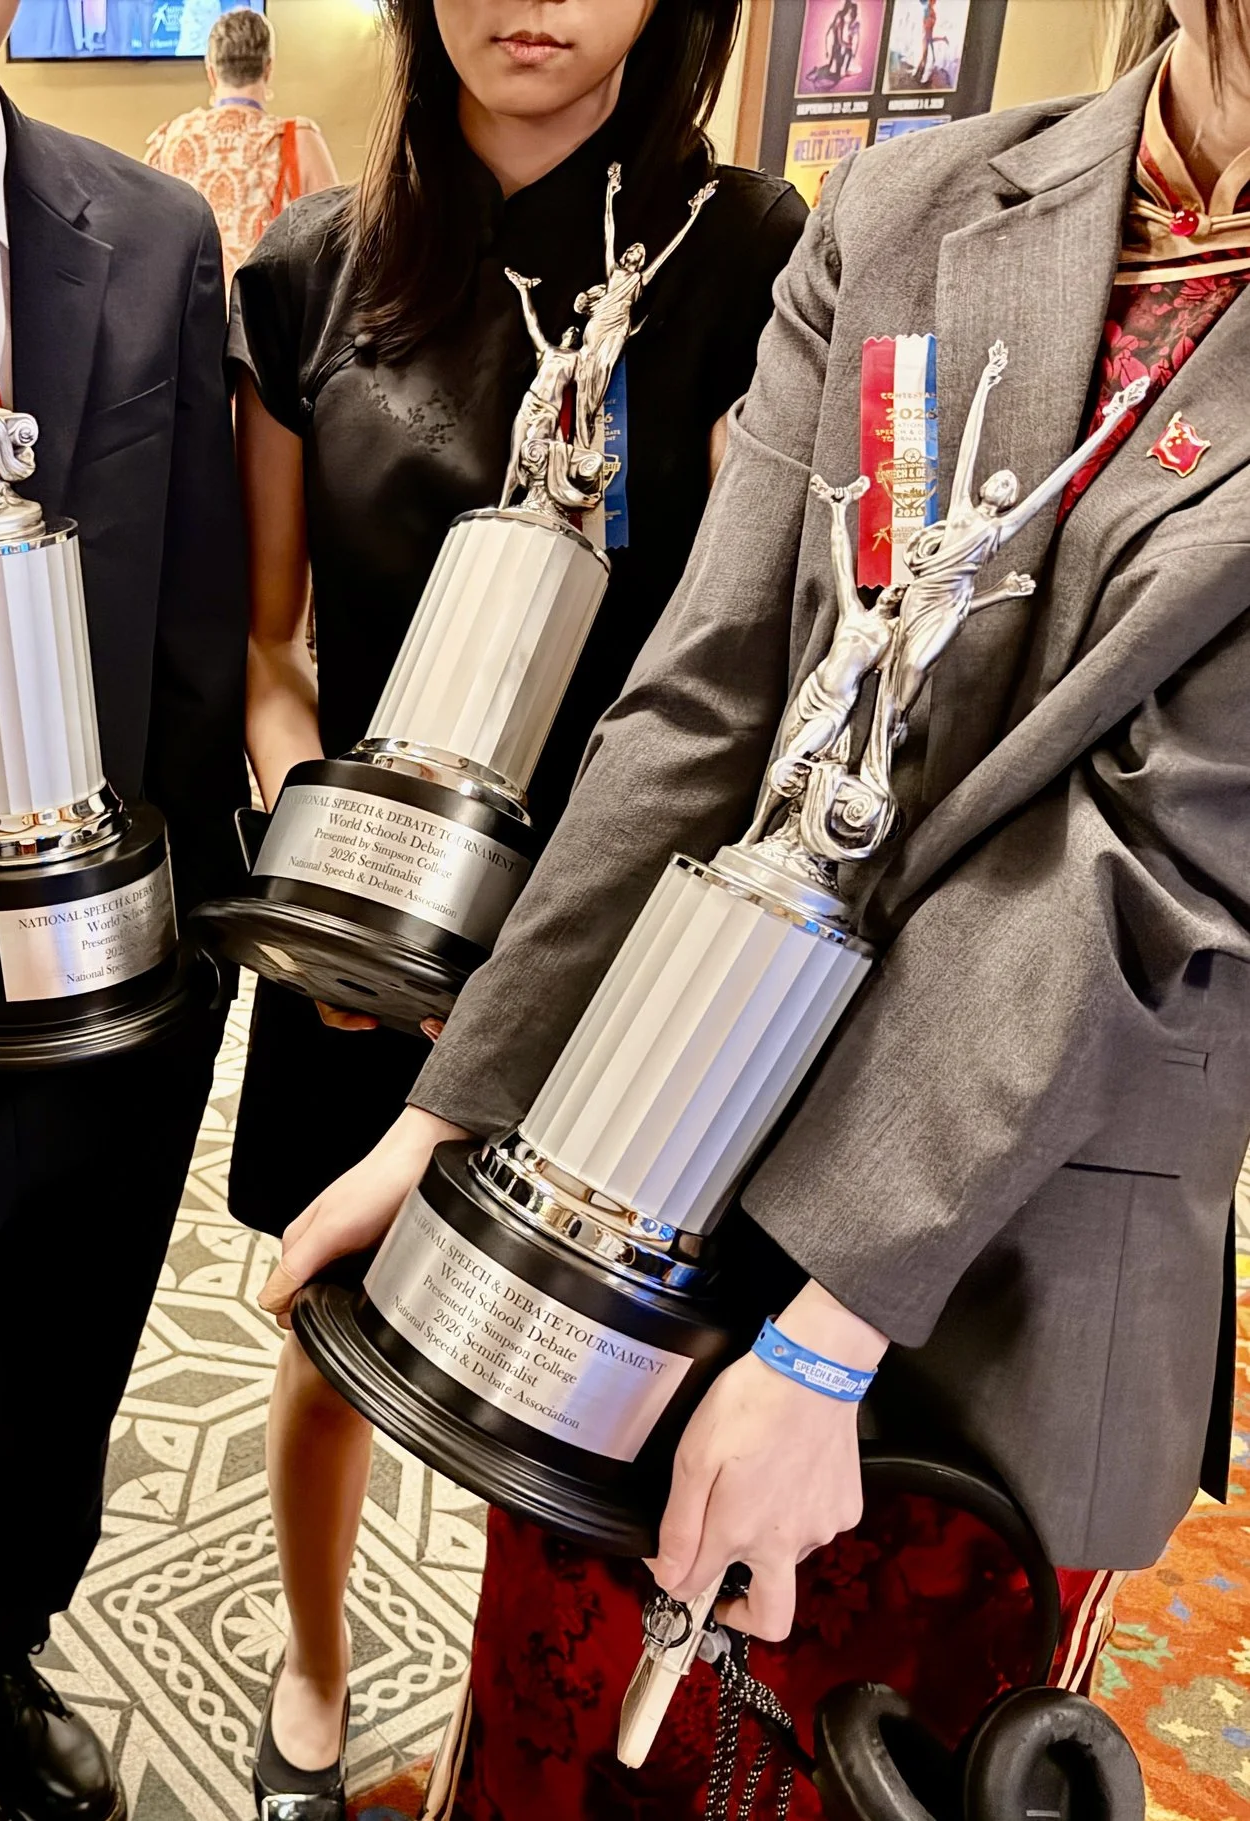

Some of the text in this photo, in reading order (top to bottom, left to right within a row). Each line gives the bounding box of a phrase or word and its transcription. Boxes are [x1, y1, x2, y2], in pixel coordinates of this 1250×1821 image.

[897, 507, 923, 517] 2026
[329, 812, 363, 832] World
[363, 820, 408, 845] Schools
[331, 798, 375, 816] SPEECH
[375, 807, 385, 820] &
[386, 810, 438, 837] DEBATE
[438, 828, 516, 873] TOURNAMENT
[314, 827, 453, 879] Presented by Simpson College
[329, 846, 423, 887] 2026 Semifinalist
[288, 855, 458, 919] National Speech & Debate Association
[18, 910, 83, 930] NATIONAL
[83, 896, 124, 919] SPEECH
[124, 896, 132, 906] &
[87, 914, 121, 933] World
[105, 944, 127, 960] 202
[66, 967, 105, 984] National
[423, 1274, 578, 1385] Presented by Simpson College
[440, 1261, 578, 1363] World Schools Debate
[446, 1244, 492, 1286] SPEECH
[491, 1279, 503, 1295] &
[502, 1286, 564, 1332] DEBATE
[564, 1322, 667, 1376] TOURNAMENT
[392, 1294, 581, 1430] National Speech & Debate Association
[433, 1308, 539, 1388] 2026 Semifinalist
[796, 1361, 826, 1380] SPEECH
[832, 1375, 856, 1391] DEBATE
